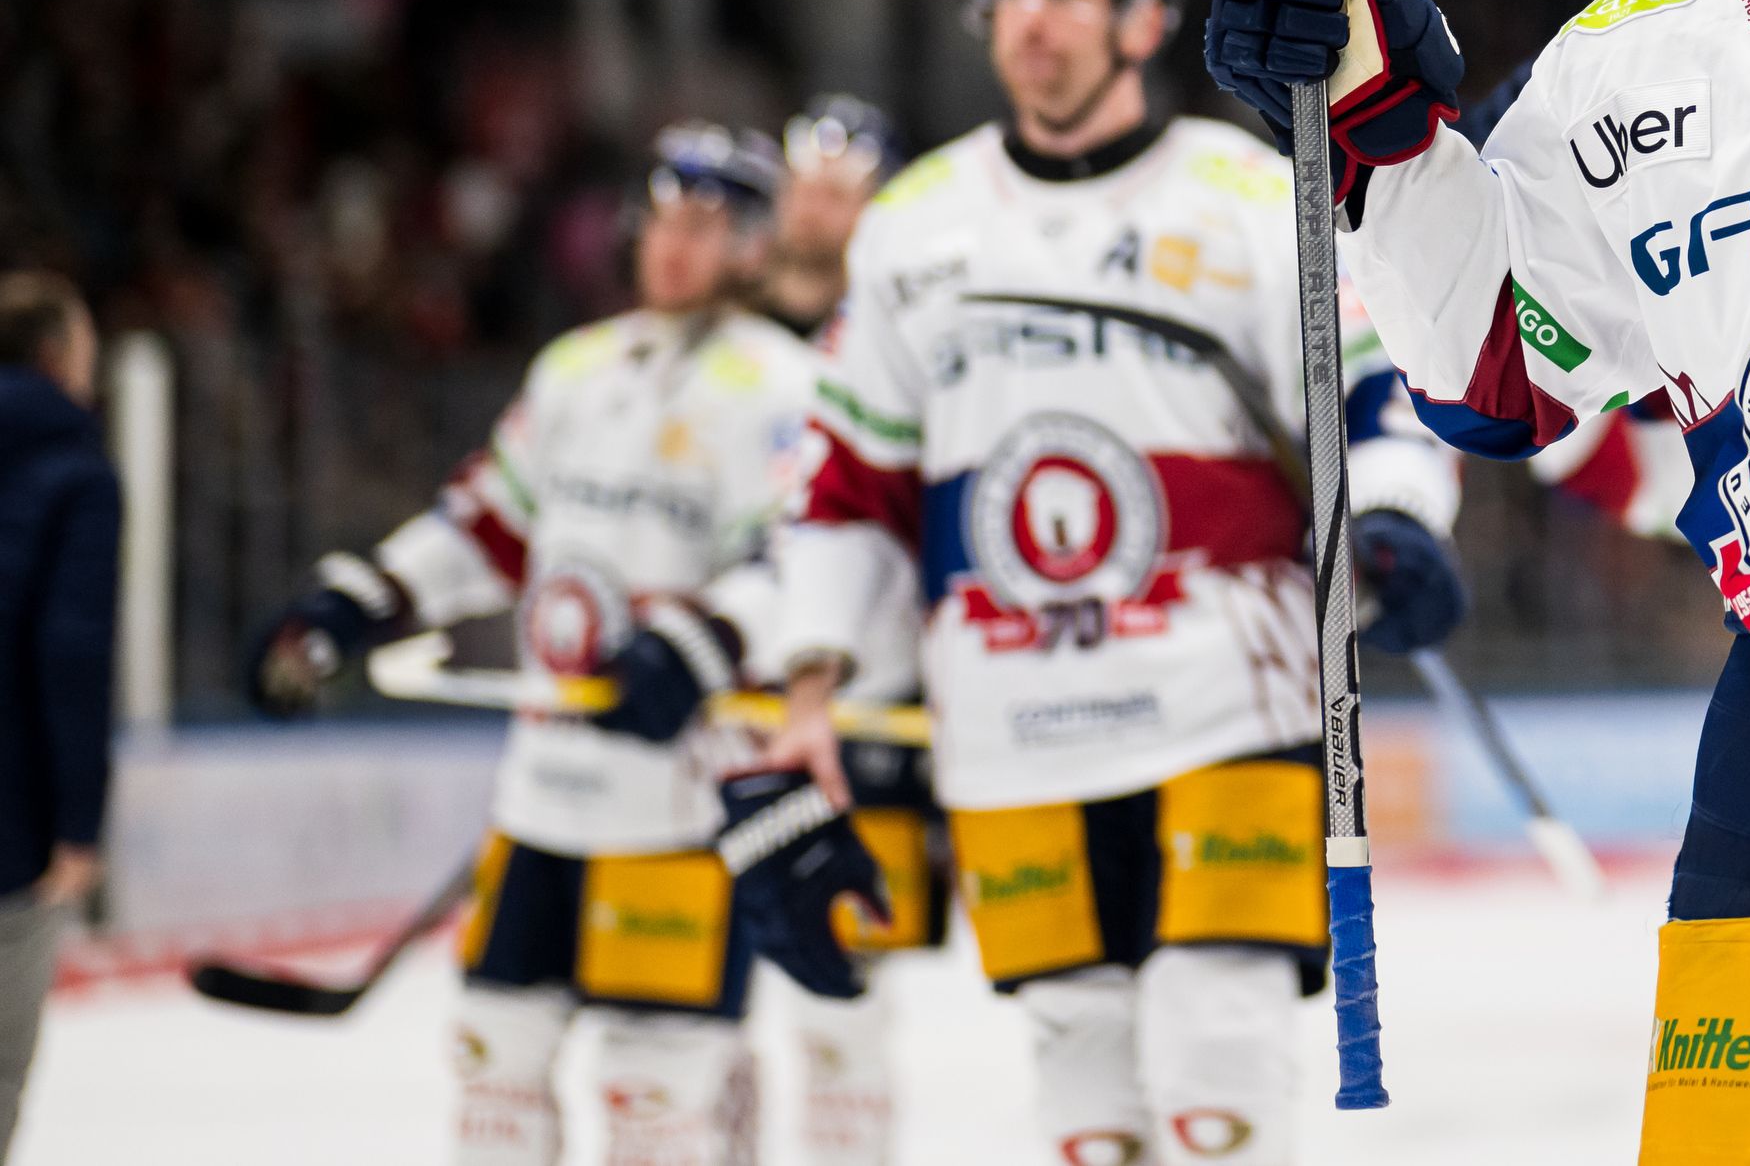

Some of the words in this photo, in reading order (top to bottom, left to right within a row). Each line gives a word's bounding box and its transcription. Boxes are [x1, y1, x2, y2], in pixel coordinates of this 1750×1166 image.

[1570, 105, 1697, 188] Uber
[1301, 159, 1330, 386] HYPERLITE
[1513, 296, 1559, 346] IGO
